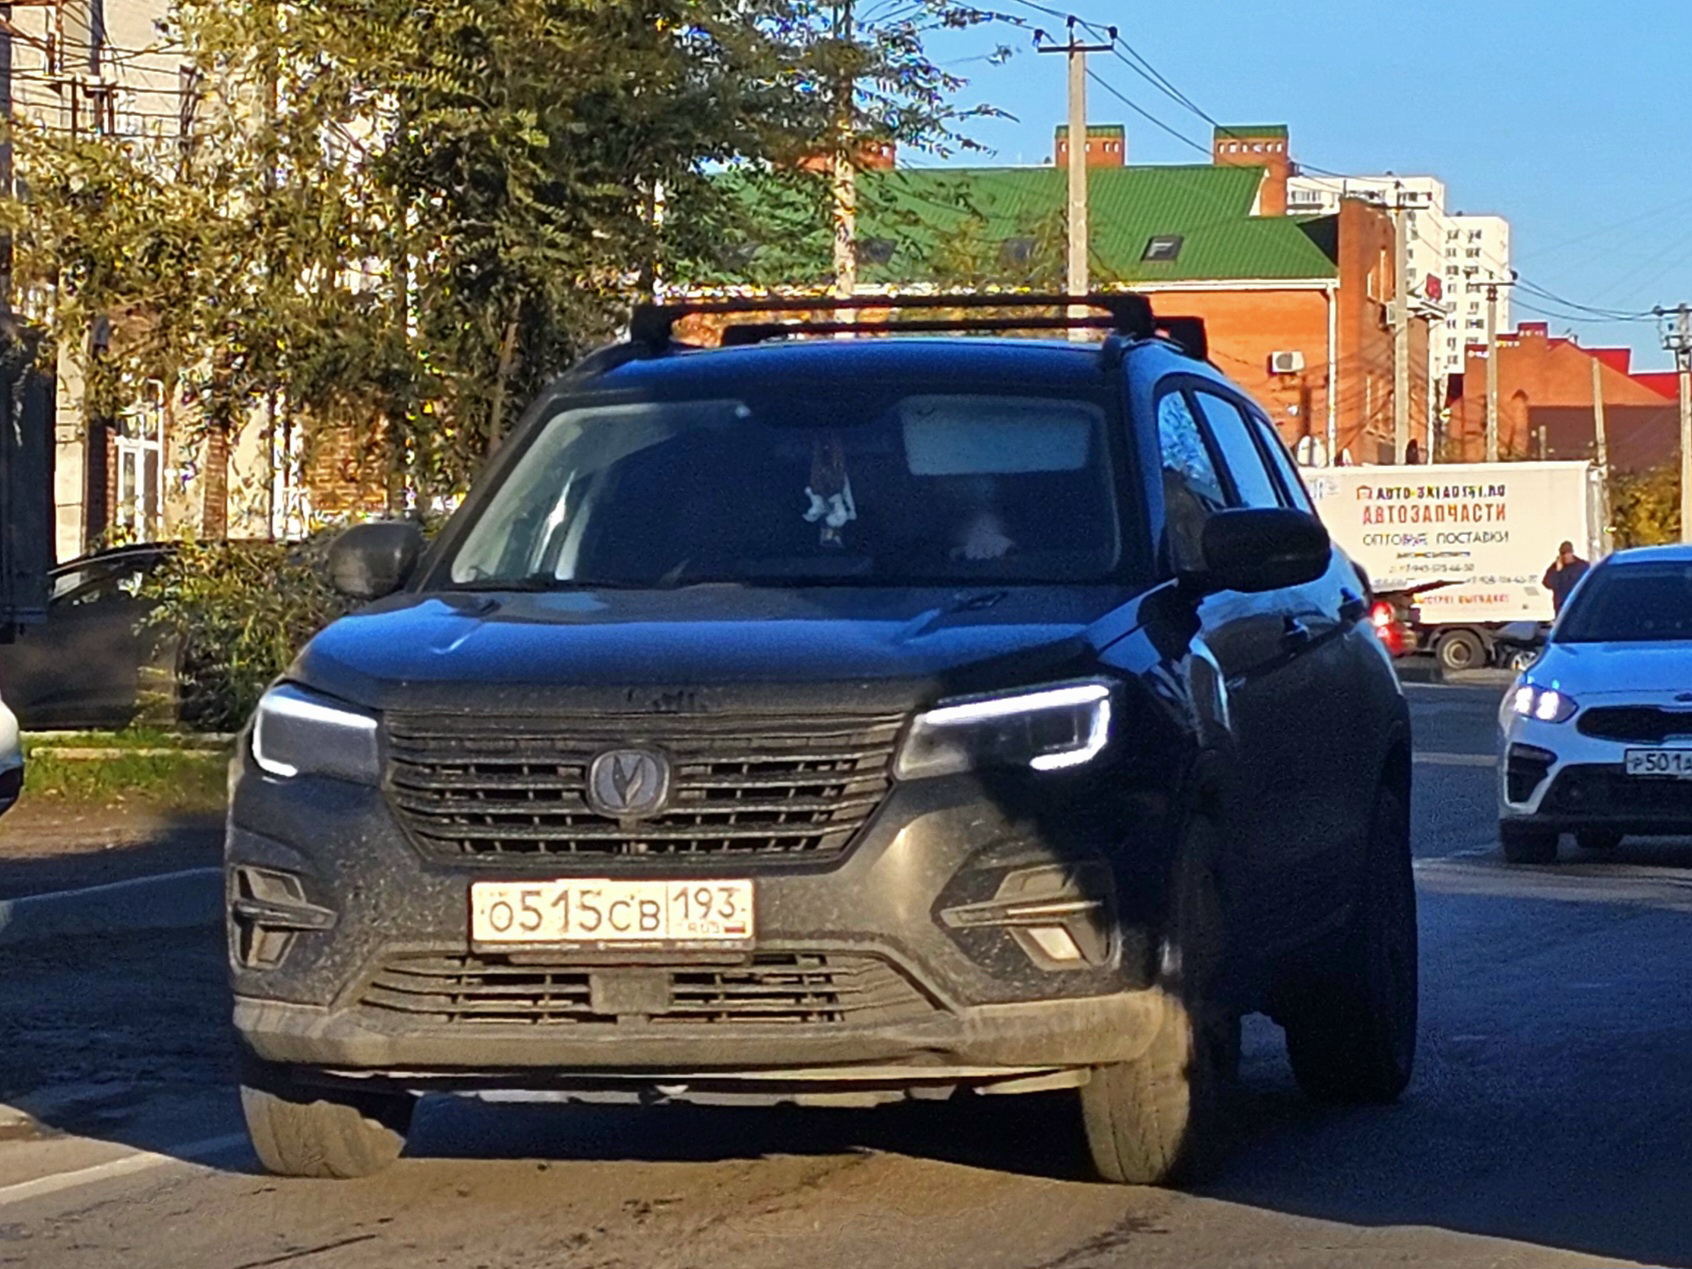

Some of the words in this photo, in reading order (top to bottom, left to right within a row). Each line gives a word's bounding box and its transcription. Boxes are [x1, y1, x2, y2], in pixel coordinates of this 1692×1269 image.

[1363, 503, 1506, 524] АВТОЗАПЧАСТИ
[1436, 530, 1509, 545] ПОСТАВКИ
[672, 886, 738, 920] 193
